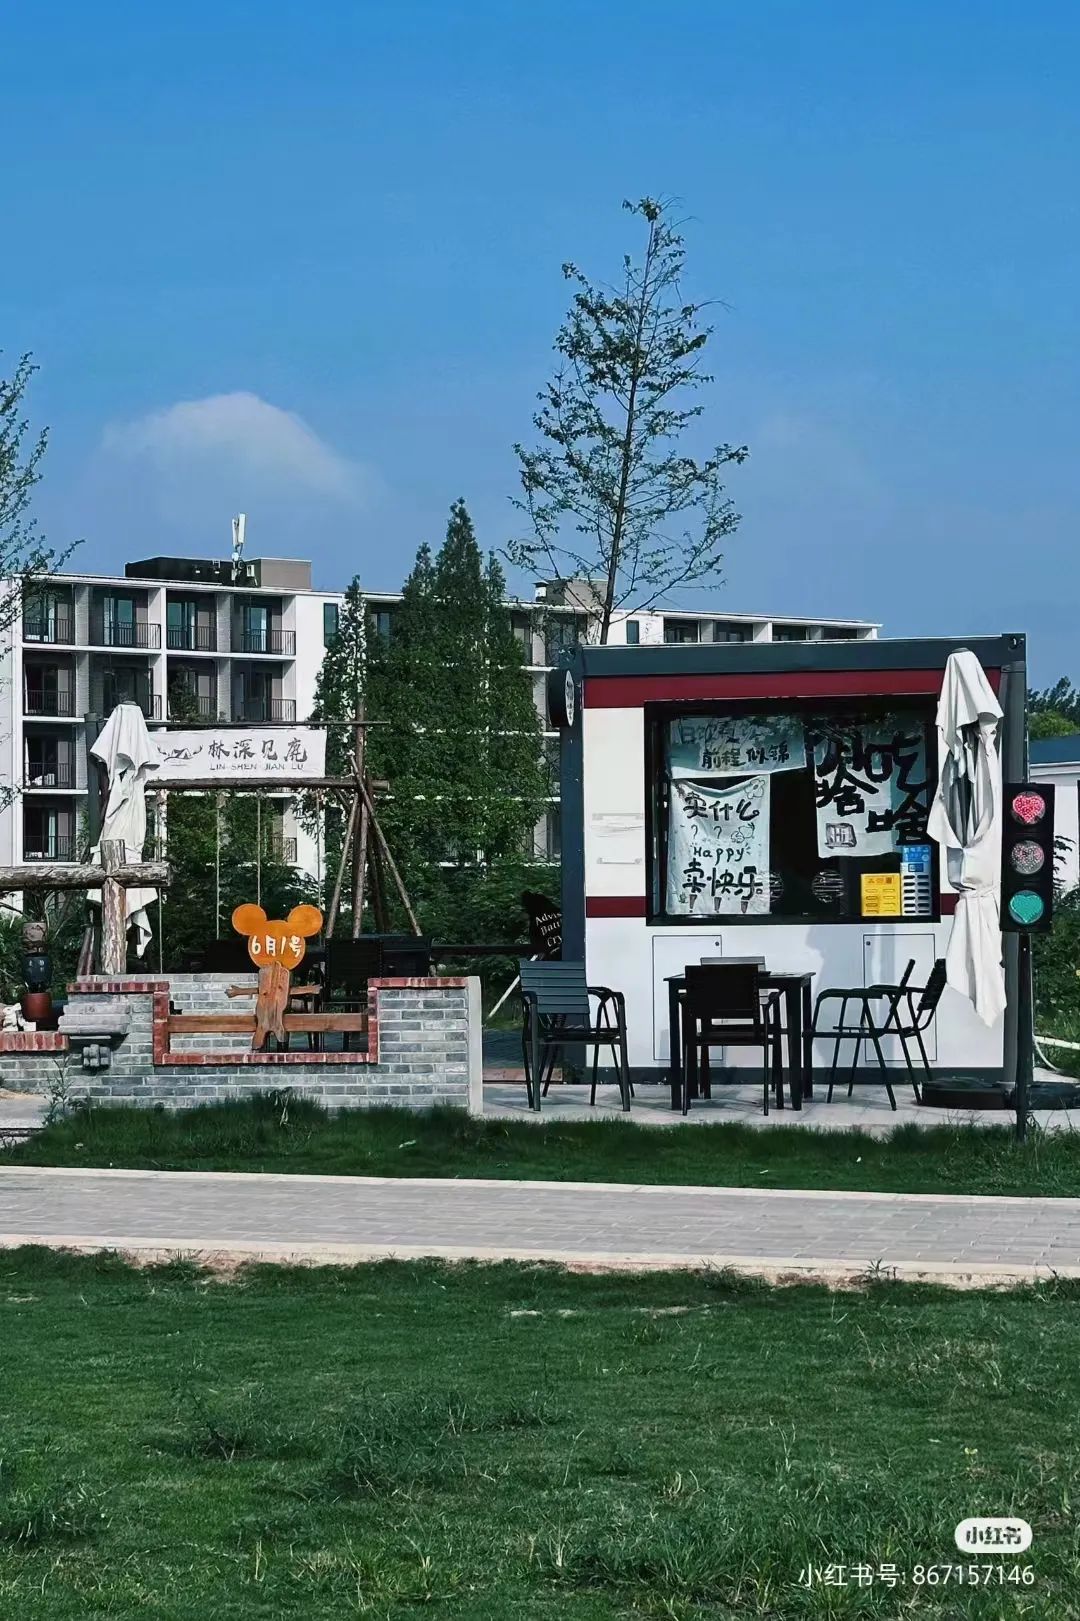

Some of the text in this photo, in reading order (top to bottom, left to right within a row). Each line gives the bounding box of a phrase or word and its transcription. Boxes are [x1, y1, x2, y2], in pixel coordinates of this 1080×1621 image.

[208, 737, 308, 763] 林深见鹿
[702, 741, 790, 769] 前程似锦
[210, 763, 305, 771] LIN SHEN JIAN LU
[693, 846, 745, 865] Happy
[251, 935, 301, 957] 6月1号
